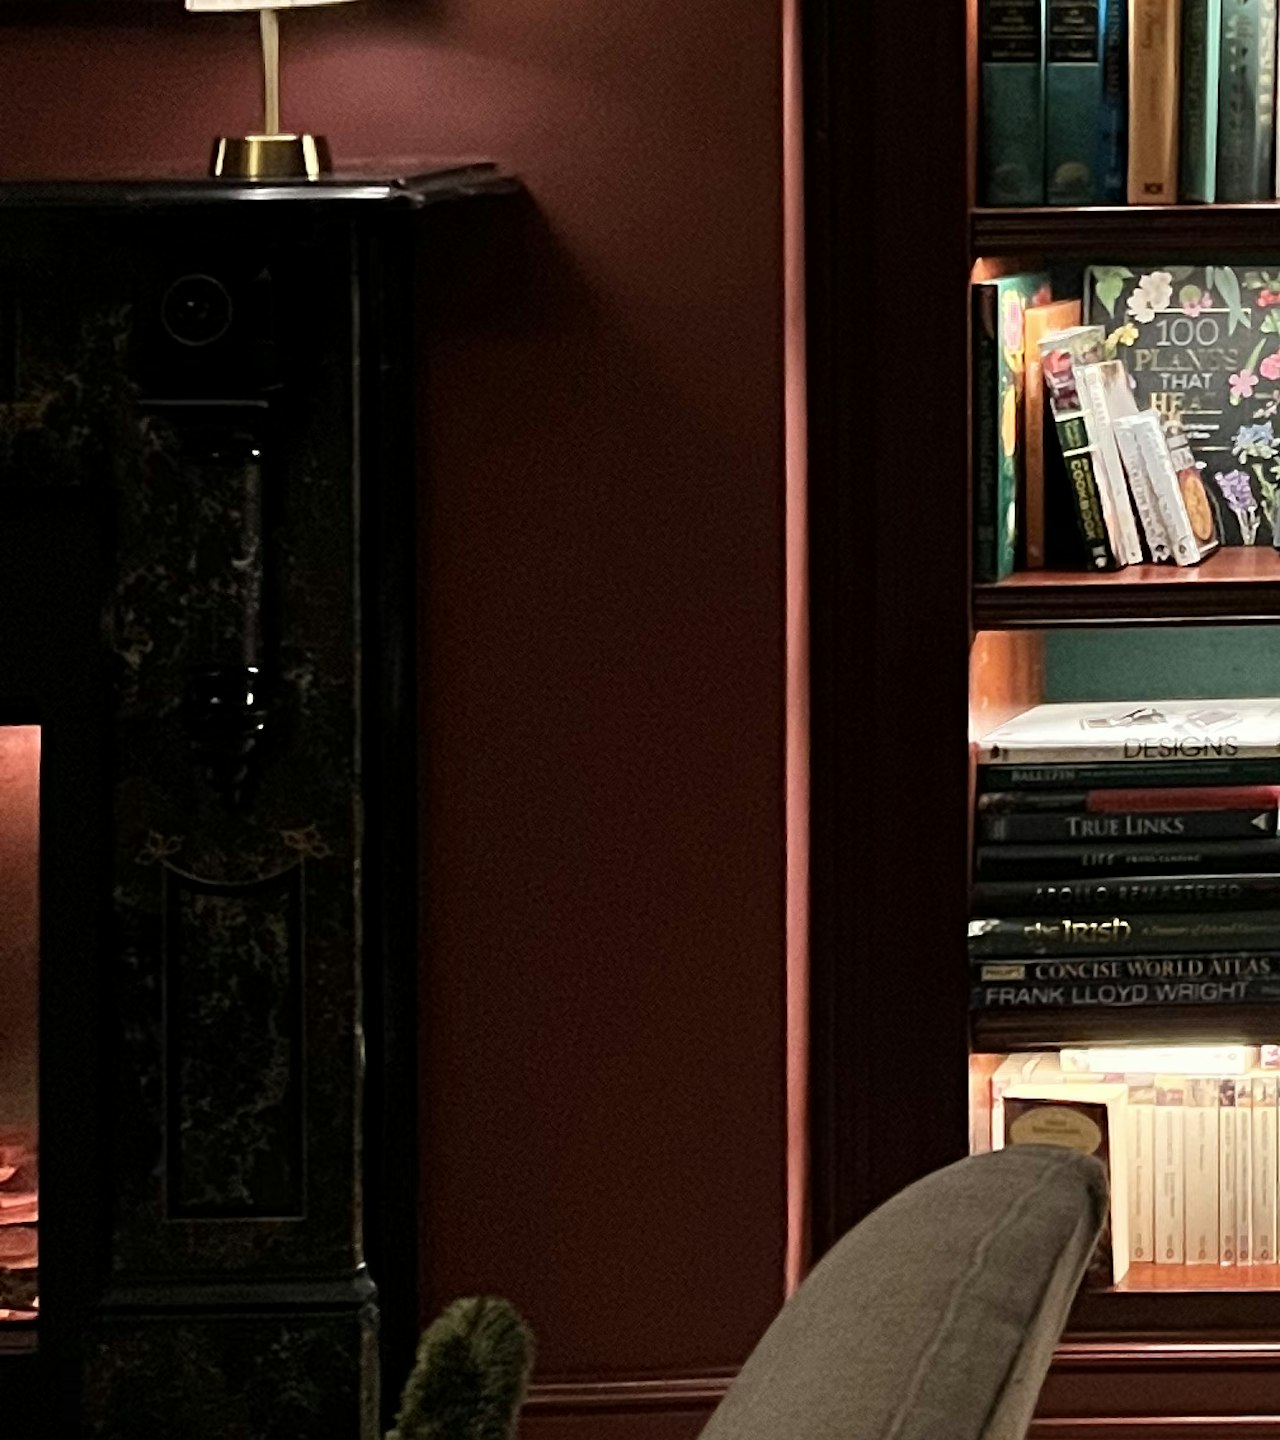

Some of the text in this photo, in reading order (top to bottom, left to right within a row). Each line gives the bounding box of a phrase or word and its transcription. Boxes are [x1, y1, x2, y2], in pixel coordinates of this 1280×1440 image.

[1156, 318, 1219, 346] 100
[1161, 372, 1213, 390] THAT
[1068, 458, 1097, 543] COOKBOOK
[1123, 736, 1239, 759] DESIGNS
[1065, 814, 1185, 838] TRUE LINKS
[1034, 885, 1108, 905] APOLLO
[1035, 961, 1122, 980] CONCISE
[1127, 960, 1204, 978] WORLD
[1208, 957, 1271, 977] ATLAS
[985, 981, 1250, 1006] FRANK LLOYD WRIGHT
